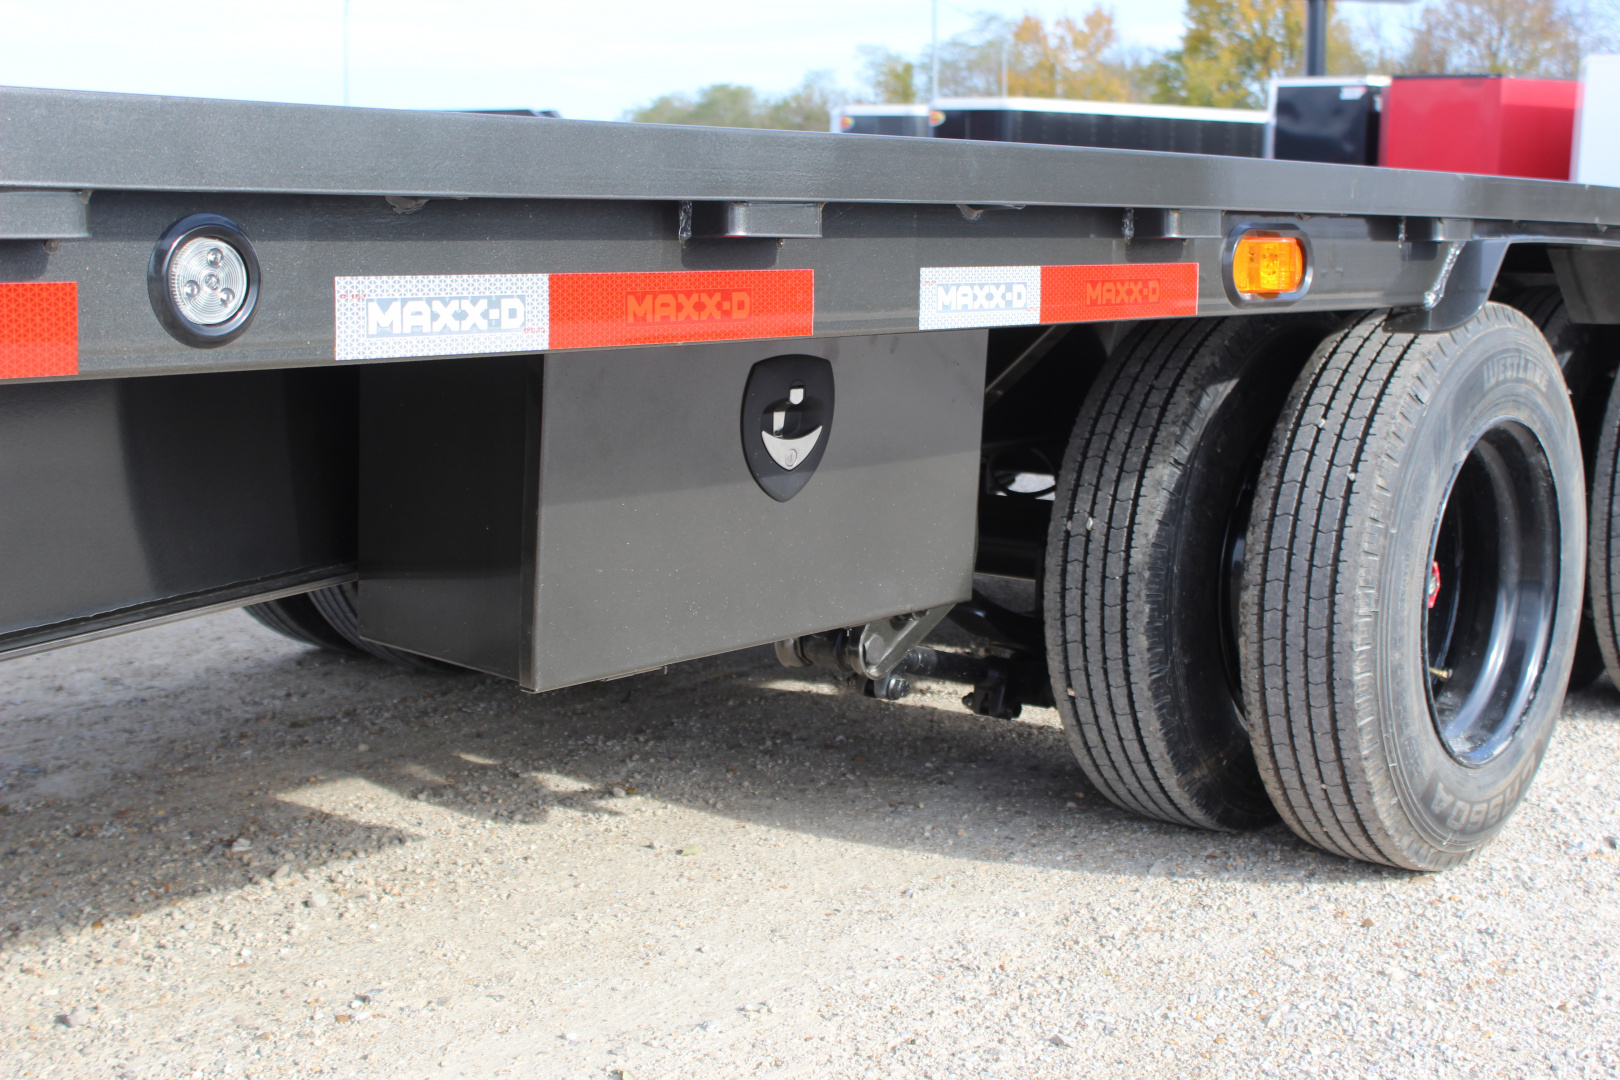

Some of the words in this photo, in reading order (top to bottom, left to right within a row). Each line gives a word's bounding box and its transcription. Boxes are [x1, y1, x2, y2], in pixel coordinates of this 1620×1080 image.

[627, 291, 750, 323] MAXX-D
[937, 284, 1026, 311] MAXX-D
[1086, 280, 1159, 305] MAXX-D
[368, 298, 525, 334] MAXX-D
[1483, 353, 1549, 392] WESTLAKE
